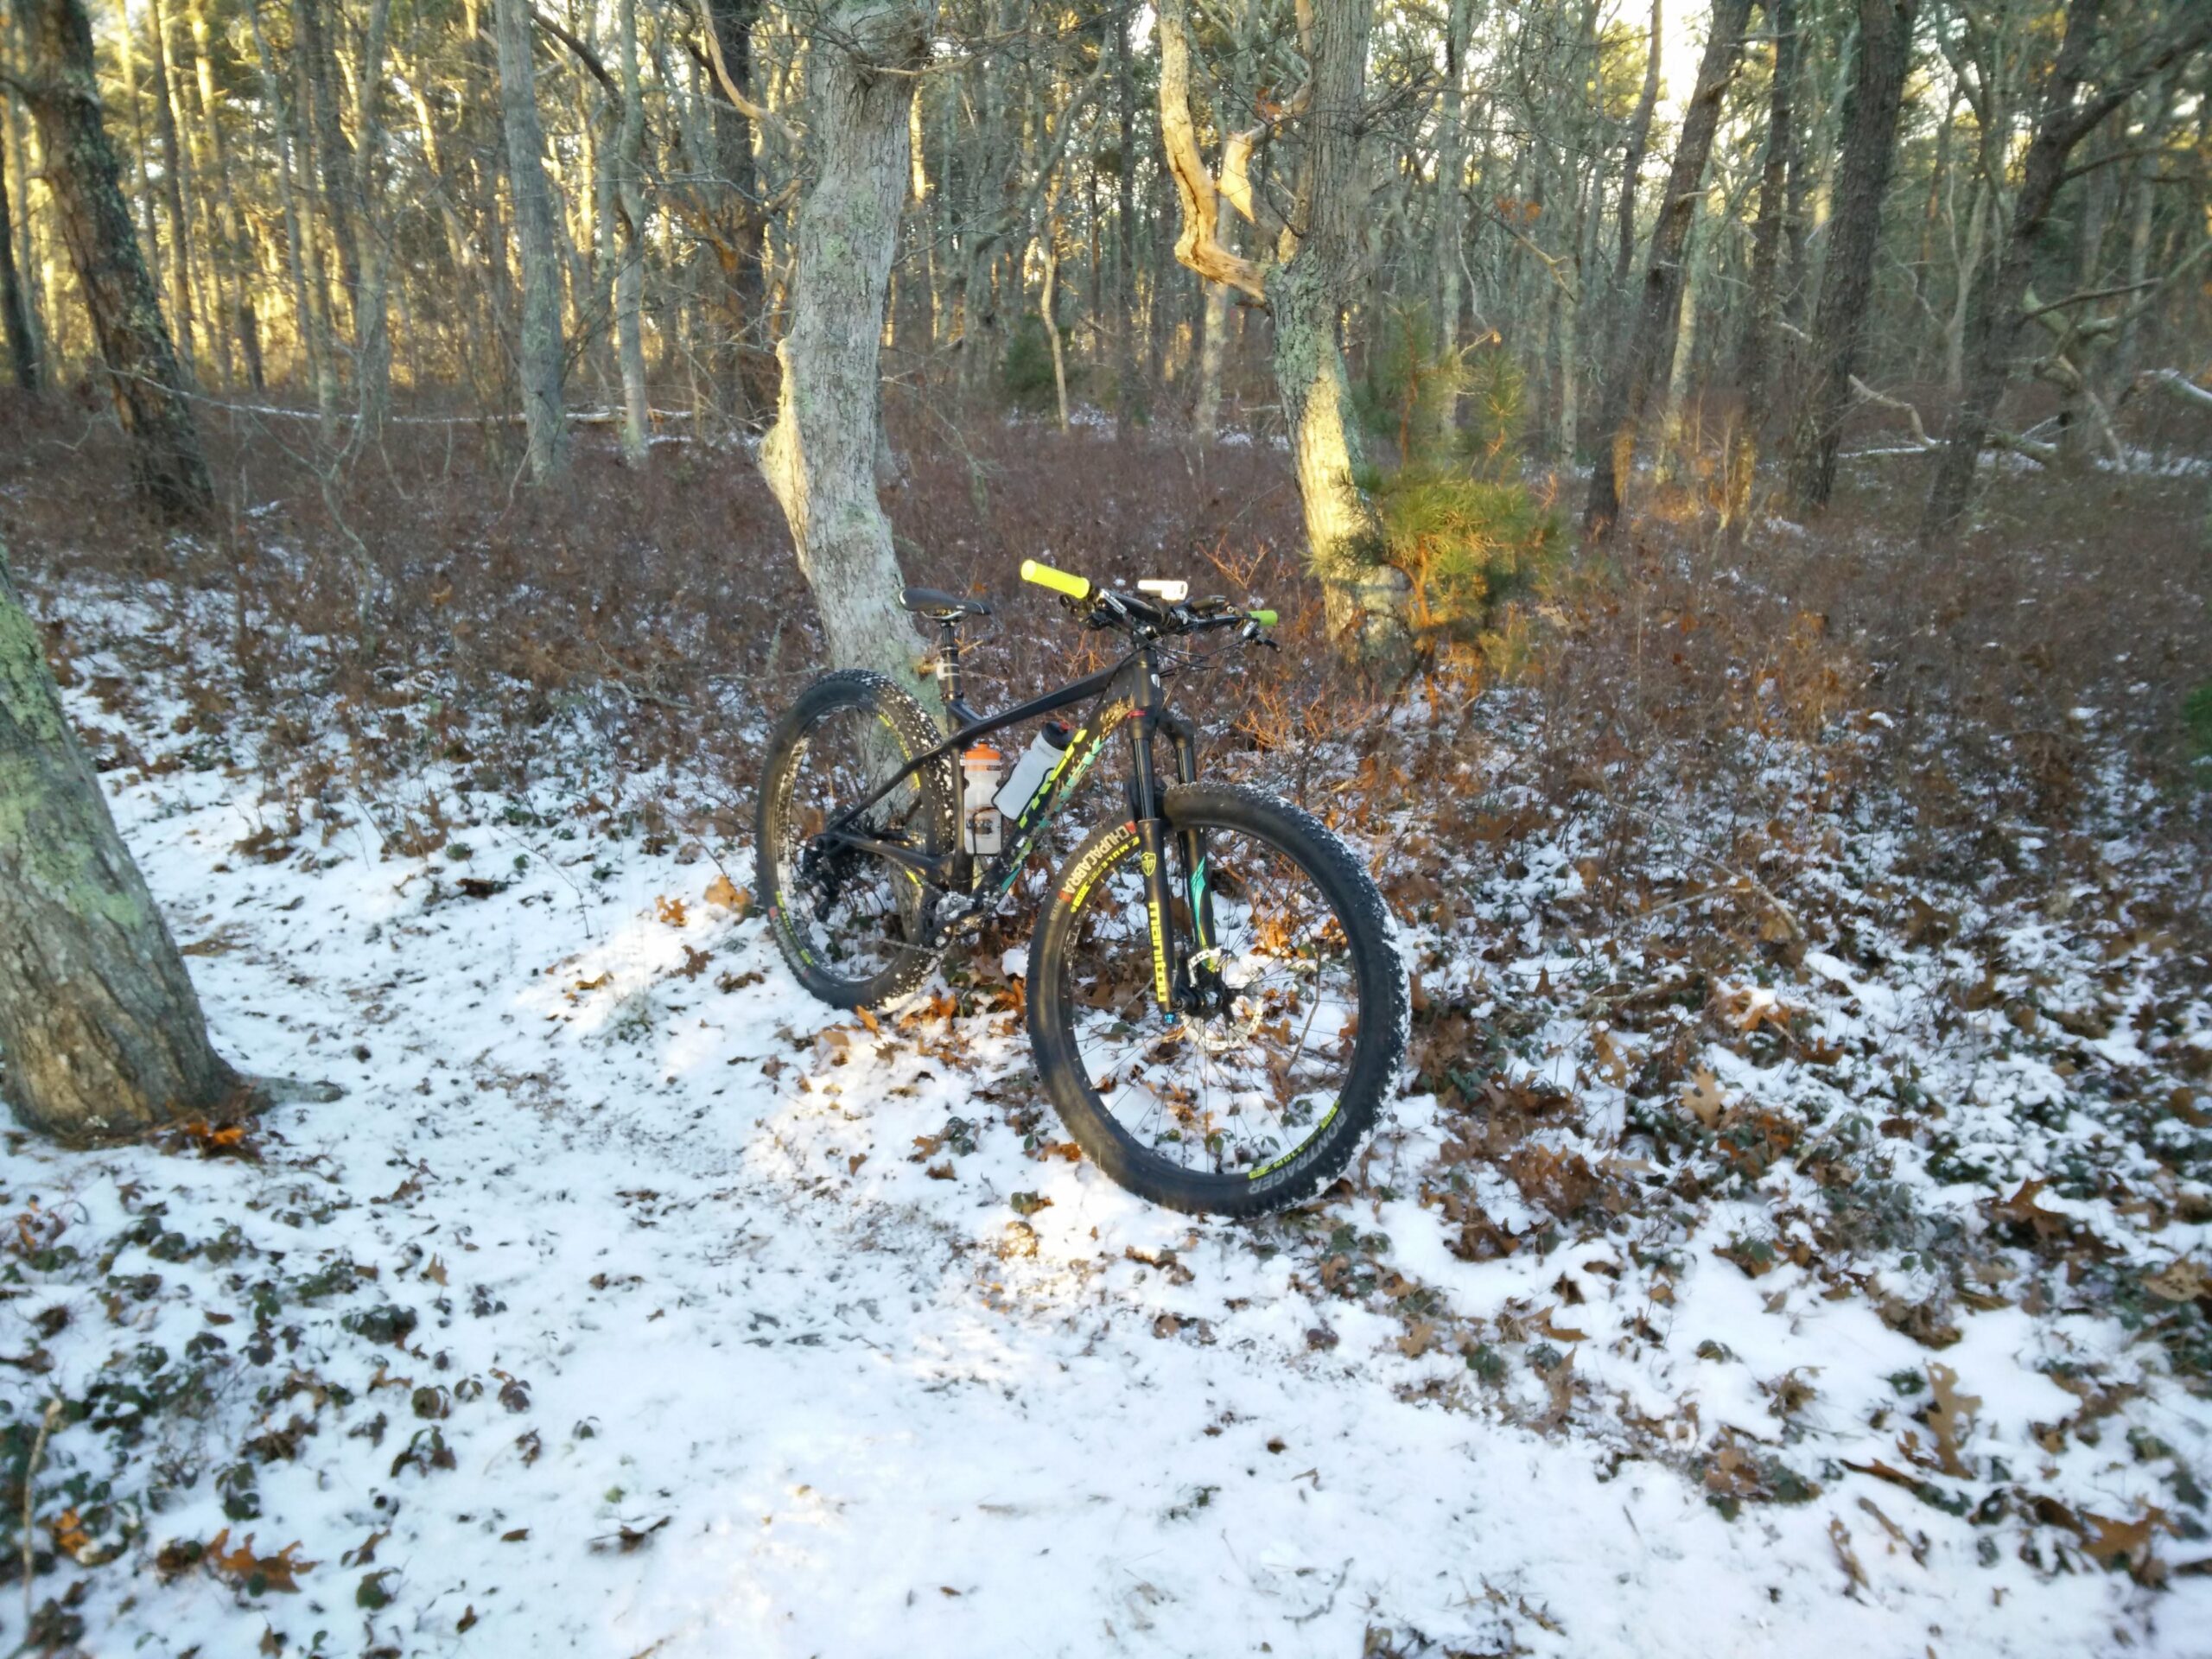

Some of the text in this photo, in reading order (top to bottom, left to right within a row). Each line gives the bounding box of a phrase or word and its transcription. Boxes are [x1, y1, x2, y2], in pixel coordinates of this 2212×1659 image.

[1062, 825, 1131, 893] CHUPACABRA
[1149, 901, 1166, 1002] manitou
[1249, 1109, 1347, 1195] BONTRAGER
